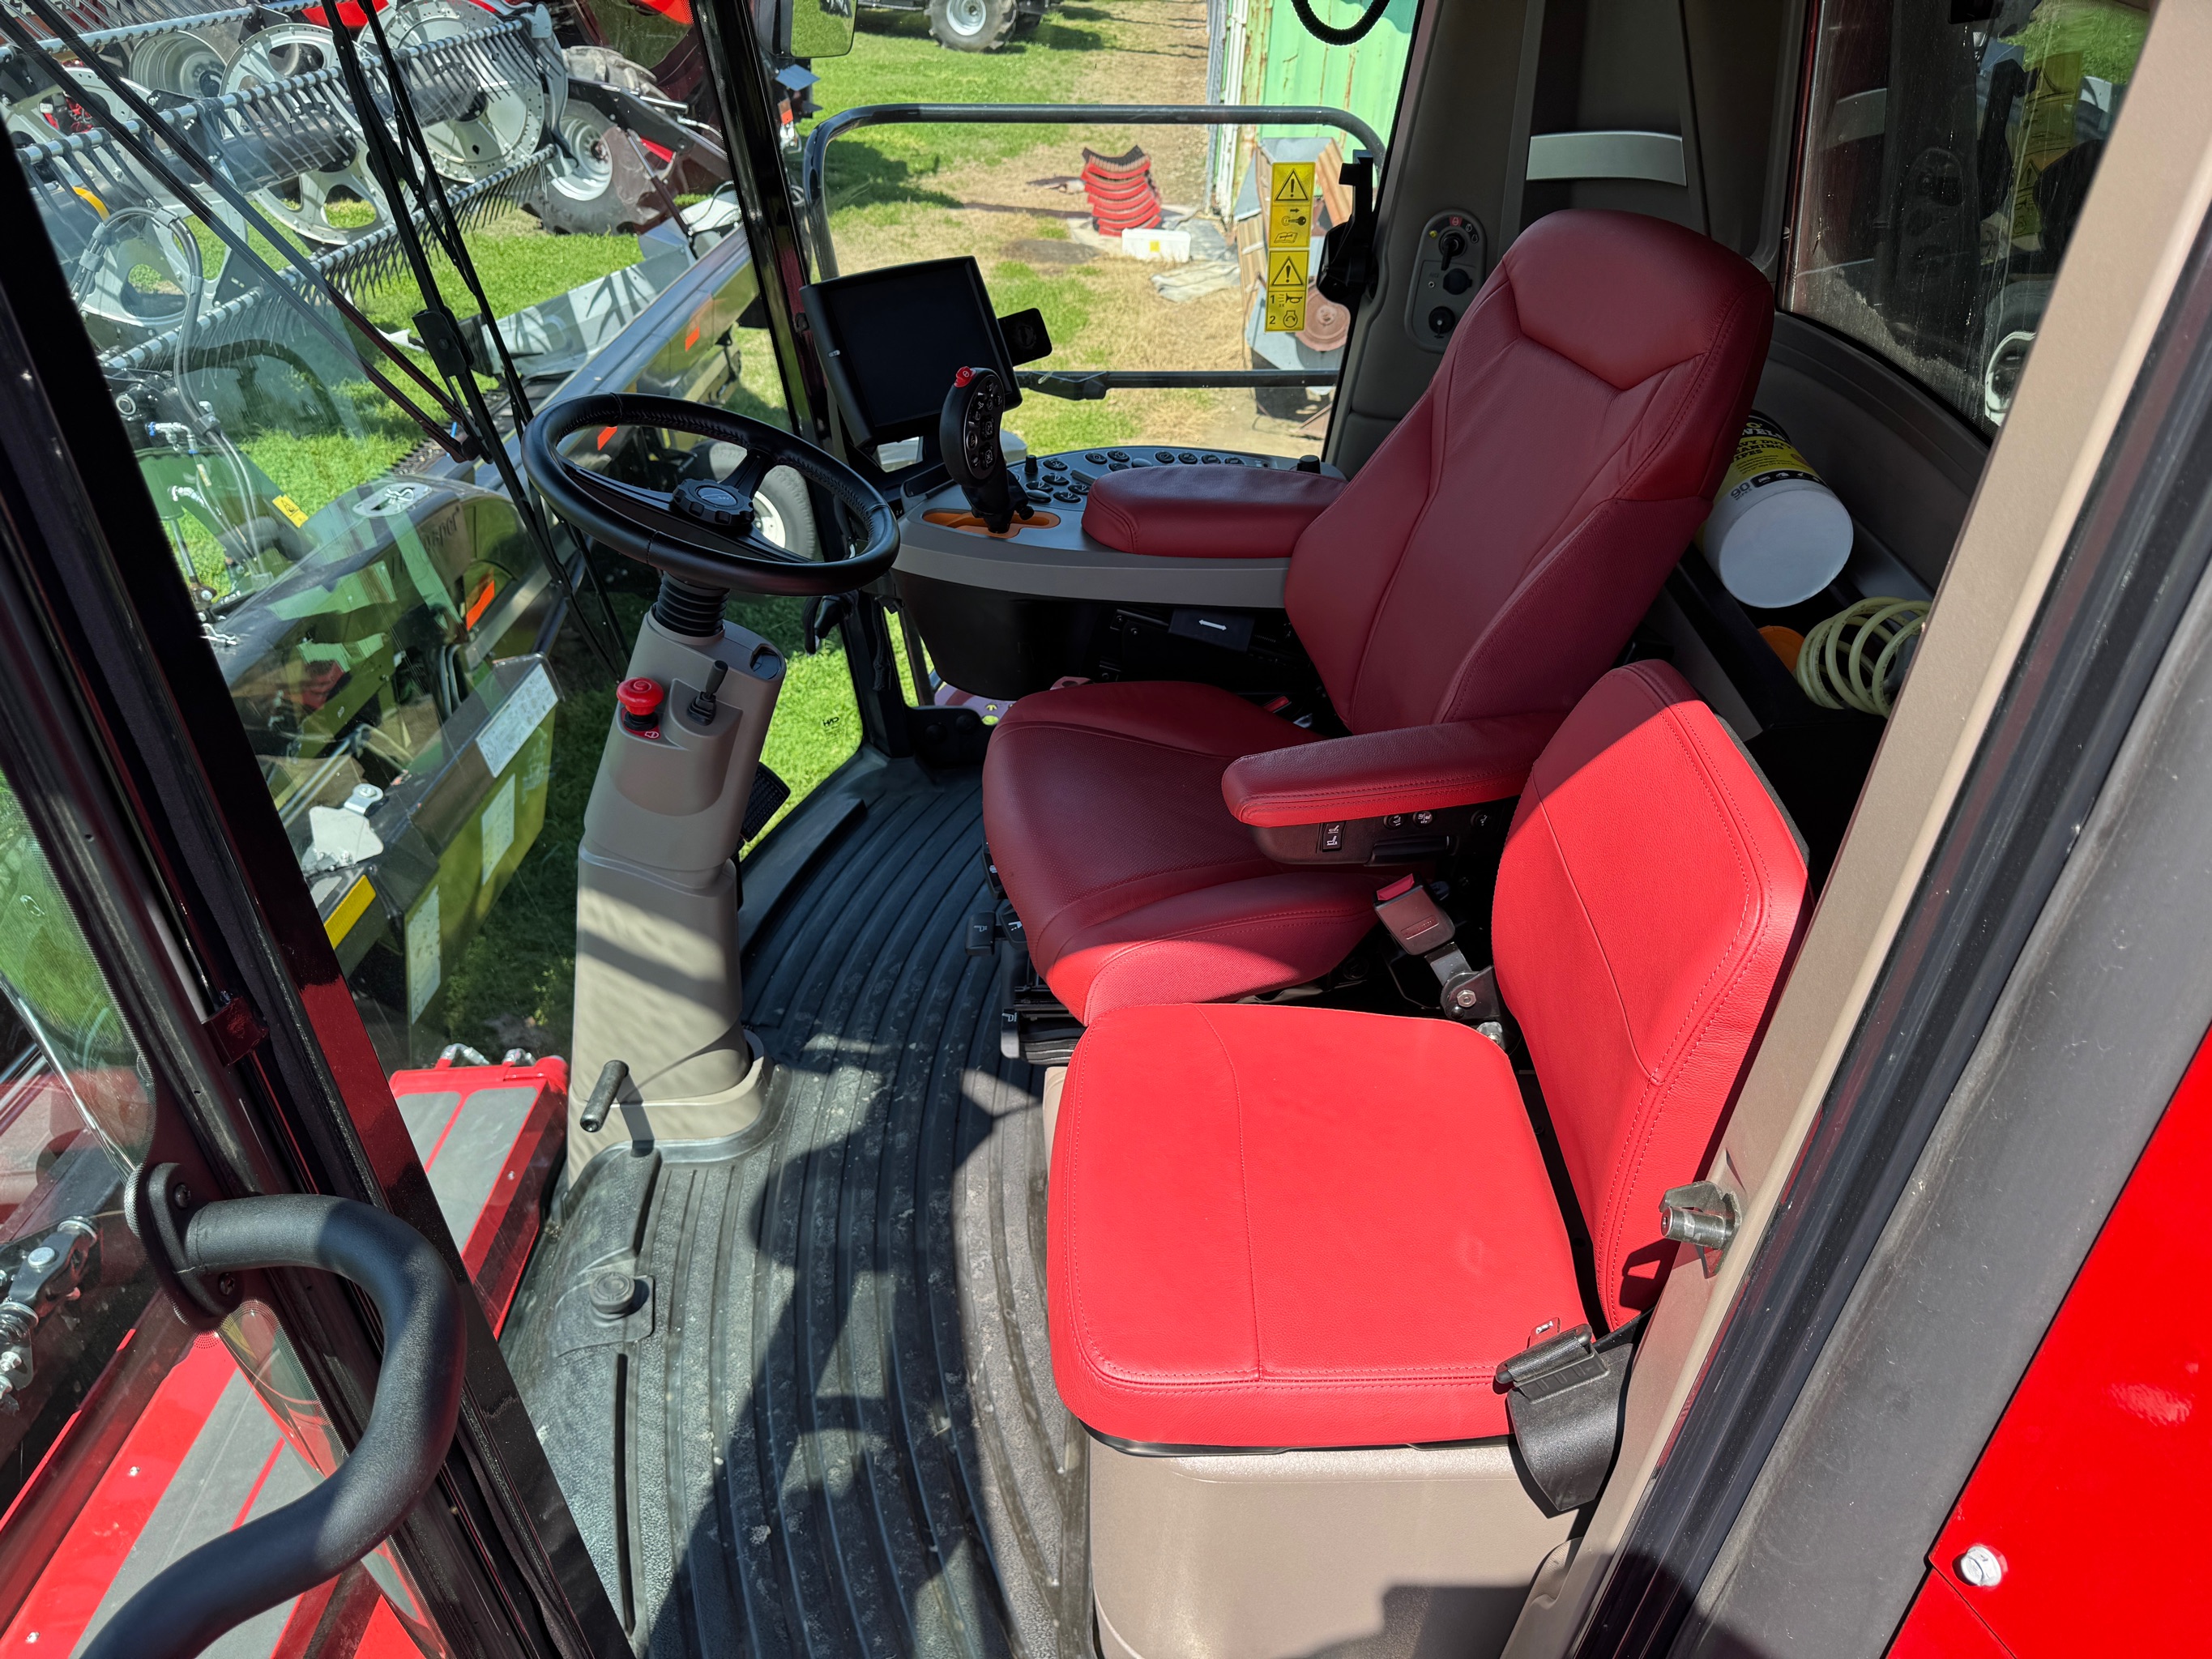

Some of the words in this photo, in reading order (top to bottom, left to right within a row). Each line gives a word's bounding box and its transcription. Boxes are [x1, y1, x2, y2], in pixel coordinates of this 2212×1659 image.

[1270, 295, 1275, 304] 1
[1269, 315, 1275, 324] 2
[1741, 428, 1787, 441] WELS
[1736, 444, 1784, 454] ANING
[1760, 439, 1791, 450] DUTY
[1735, 449, 1763, 460] IPES
[1731, 482, 1750, 498] 90
[1735, 488, 1753, 501] WIPES
